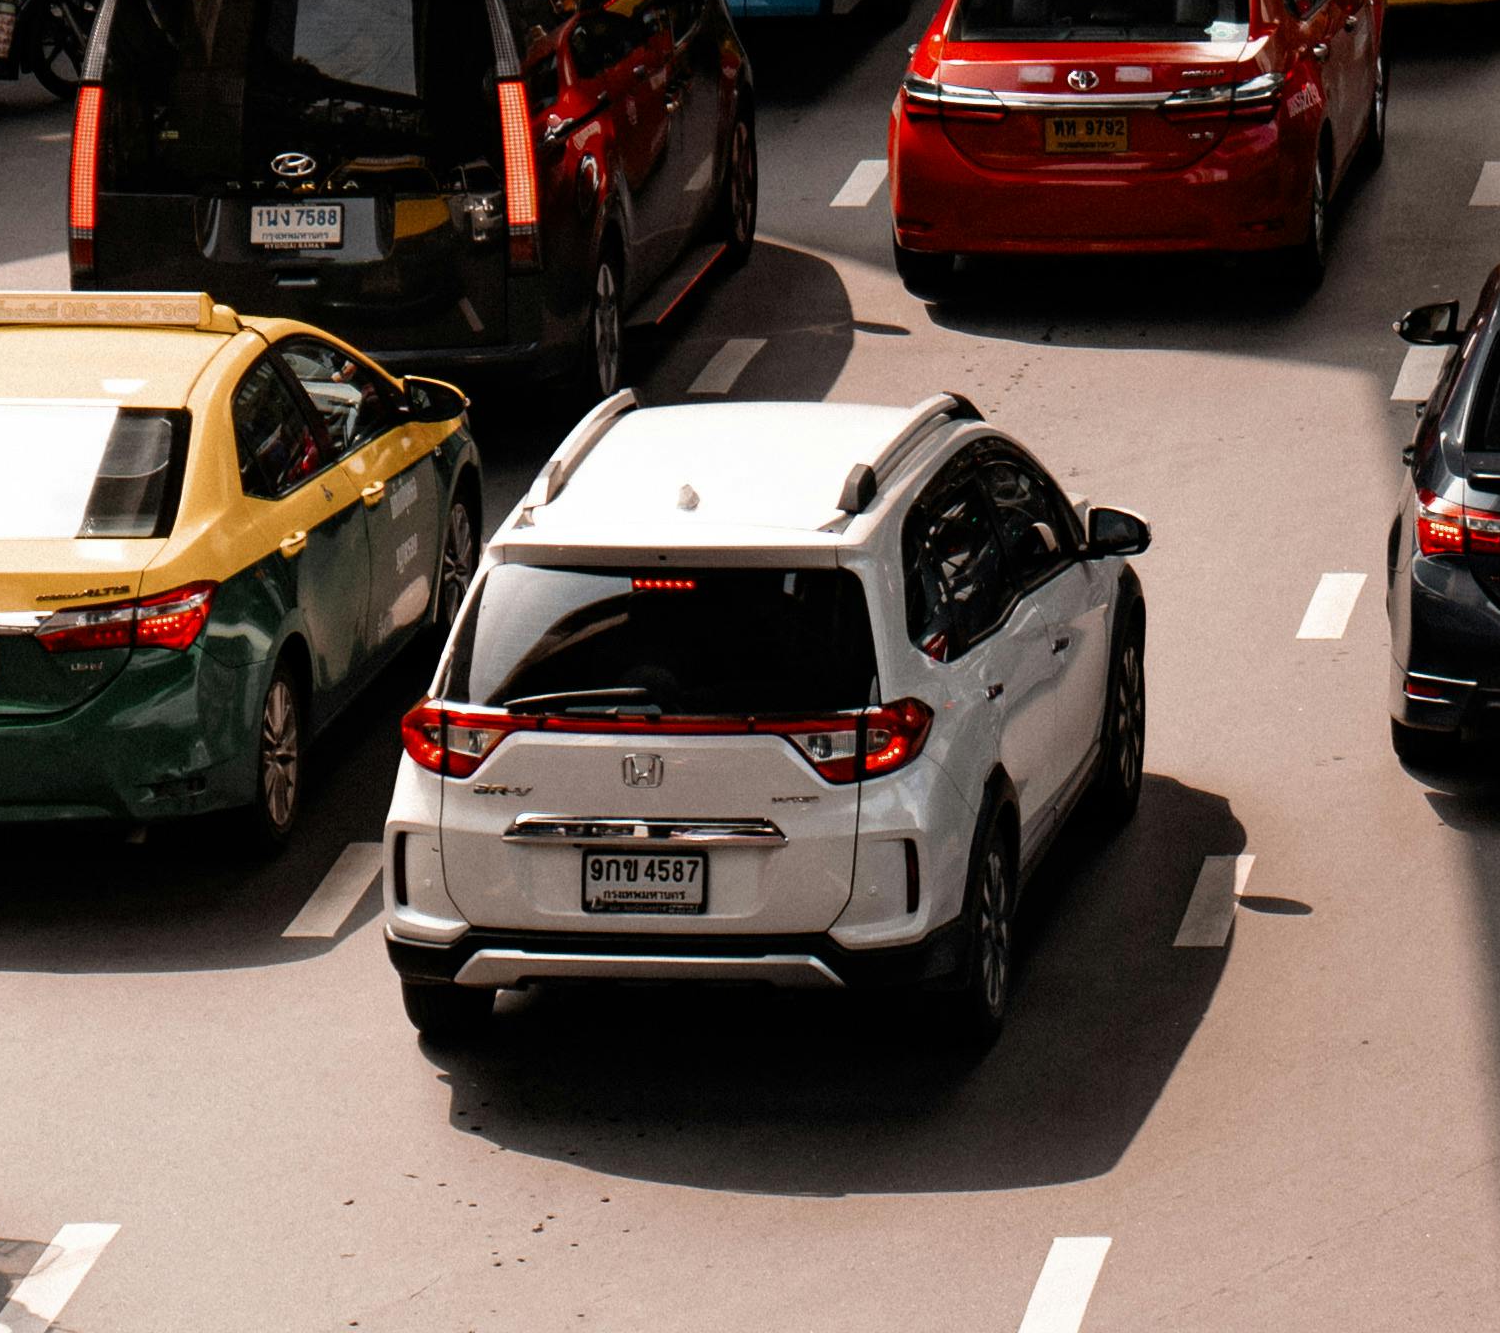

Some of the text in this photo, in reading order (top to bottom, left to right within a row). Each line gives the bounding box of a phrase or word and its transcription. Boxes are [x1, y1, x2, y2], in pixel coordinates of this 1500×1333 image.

[1086, 118, 1127, 137] 9792
[296, 208, 339, 227] 7588
[642, 854, 700, 883] 4587
